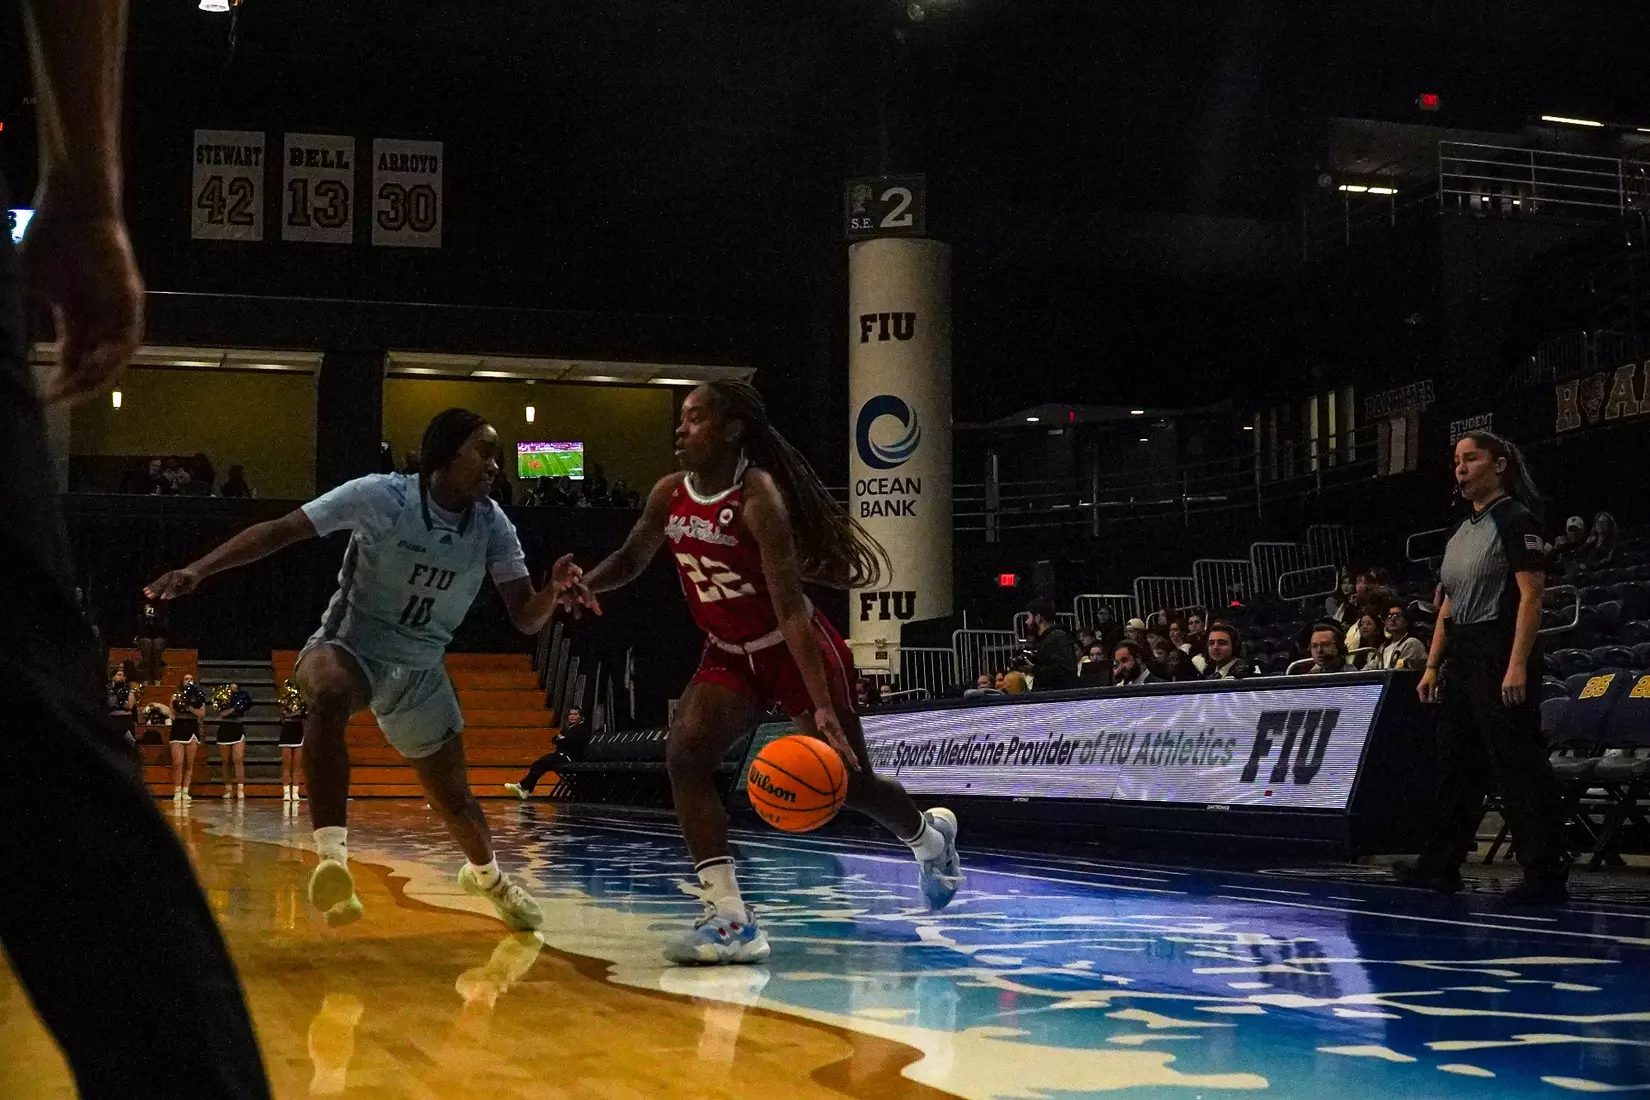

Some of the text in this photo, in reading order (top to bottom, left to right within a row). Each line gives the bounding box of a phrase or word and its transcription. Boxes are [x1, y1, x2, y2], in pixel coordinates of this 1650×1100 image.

[196, 145, 262, 167] STEWART
[289, 148, 350, 169] BELL
[378, 152, 438, 173] ARROYO
[197, 175, 255, 226] 42
[287, 178, 349, 228] 13
[377, 182, 437, 232] 30
[851, 186, 913, 230] S.E. 2
[860, 312, 916, 343] FIU
[1450, 412, 1493, 434] STUDENT
[855, 477, 921, 496] OCEAN
[860, 500, 916, 518] BANK
[407, 563, 456, 590] FIU
[675, 552, 757, 603] 22
[398, 594, 435, 627] 10
[860, 591, 916, 621] FIU
[892, 738, 934, 776] Sports
[935, 734, 1003, 766] Medicine
[1003, 731, 1080, 766] Provider
[1079, 731, 1105, 765] of
[1100, 732, 1136, 765] FIU
[1133, 727, 1237, 766] Athletics
[1240, 708, 1341, 785] FIU
[749, 763, 797, 803] Wilson
